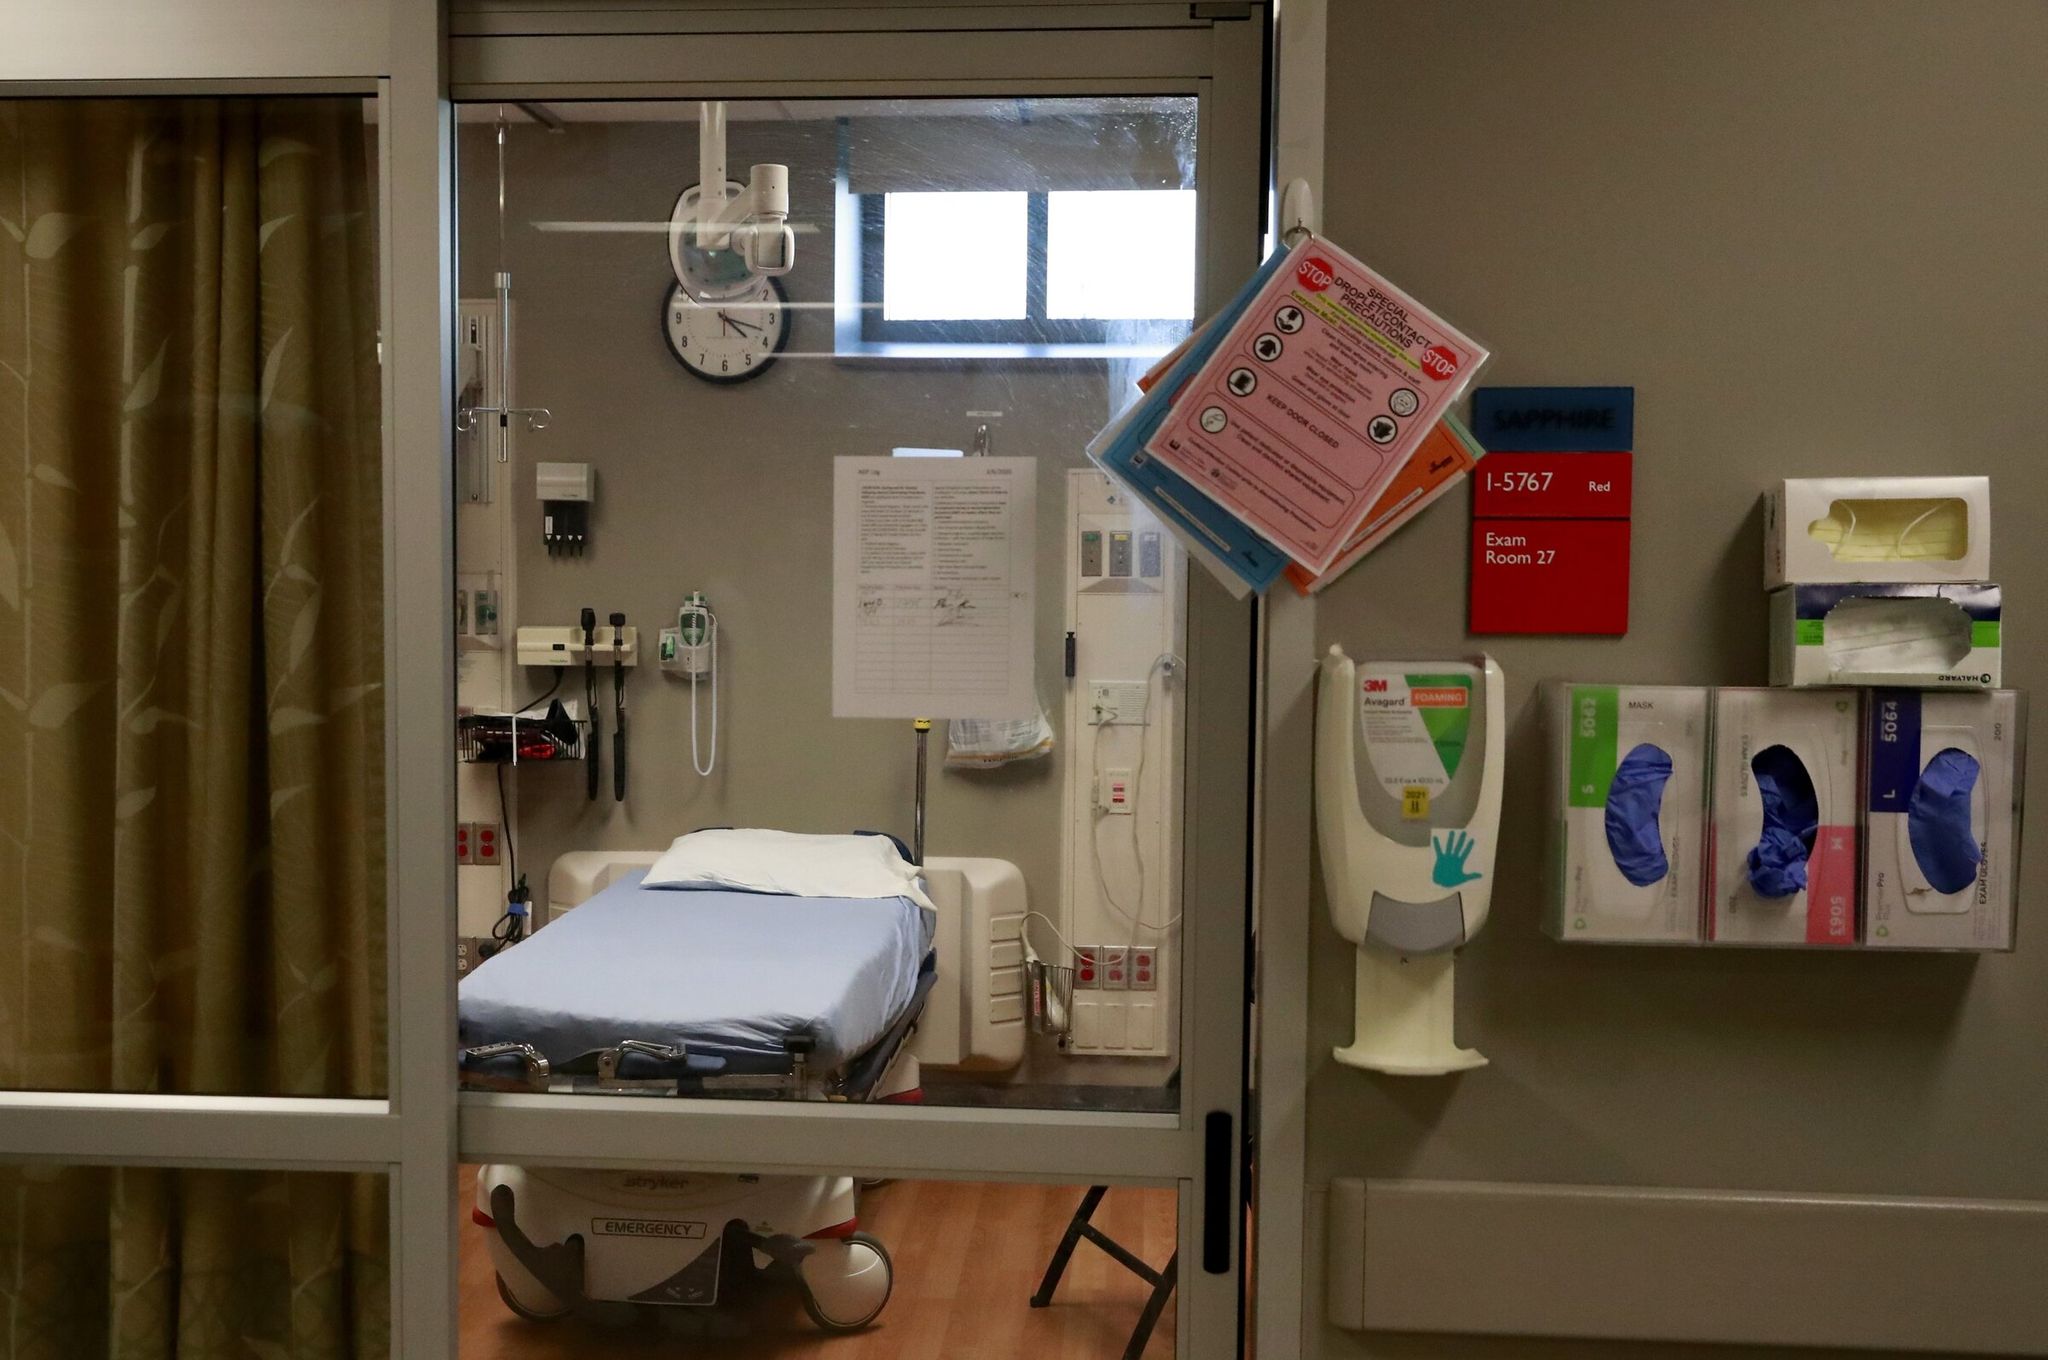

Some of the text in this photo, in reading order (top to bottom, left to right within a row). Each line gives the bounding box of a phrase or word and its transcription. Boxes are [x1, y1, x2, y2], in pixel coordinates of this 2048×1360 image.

[1297, 259, 1333, 290] STOP
[762, 289, 769, 301] 2
[1290, 290, 1320, 313] Everyone
[1366, 287, 1411, 323] SPECIAL
[675, 312, 682, 325] 9
[769, 312, 775, 325] 3
[1333, 276, 1432, 350] DROPLET/CONTACT
[1339, 292, 1413, 348] PRECAUTIONS
[681, 336, 688, 348] 8
[762, 336, 769, 348] 4
[700, 353, 705, 366] 7
[745, 354, 752, 366] 5
[1321, 327, 1389, 379] Clean hands when entering
[1328, 341, 1339, 351] and
[1338, 349, 1358, 365] leaving
[721, 360, 728, 372] 6
[1420, 348, 1457, 378] STOP
[1343, 366, 1358, 377] mask
[1306, 386, 1317, 395] and
[1328, 382, 1356, 403] protection
[1265, 393, 1340, 449] KEEP DOOR CLOSED
[1493, 408, 1615, 431] SAPPHIRE
[1487, 472, 1611, 492] I-5767 Red
[1486, 532, 1526, 547] Exam
[1486, 550, 1556, 565] Room 27
[1363, 680, 1387, 692] 3M
[1364, 698, 1405, 708] Avagard
[1415, 693, 1463, 703] FOAMING
[1628, 701, 1654, 710] MASK
[1582, 698, 1596, 794] S 5062
[1883, 700, 1898, 799] L 5064
[1740, 762, 1749, 797] GLOVES
[1405, 791, 1426, 799] 2021
[1829, 837, 1843, 937] M 5063
[1979, 877, 1987, 905] EXAM
[623, 1175, 689, 1190] stryker
[605, 1222, 693, 1236] EMERGENCY
